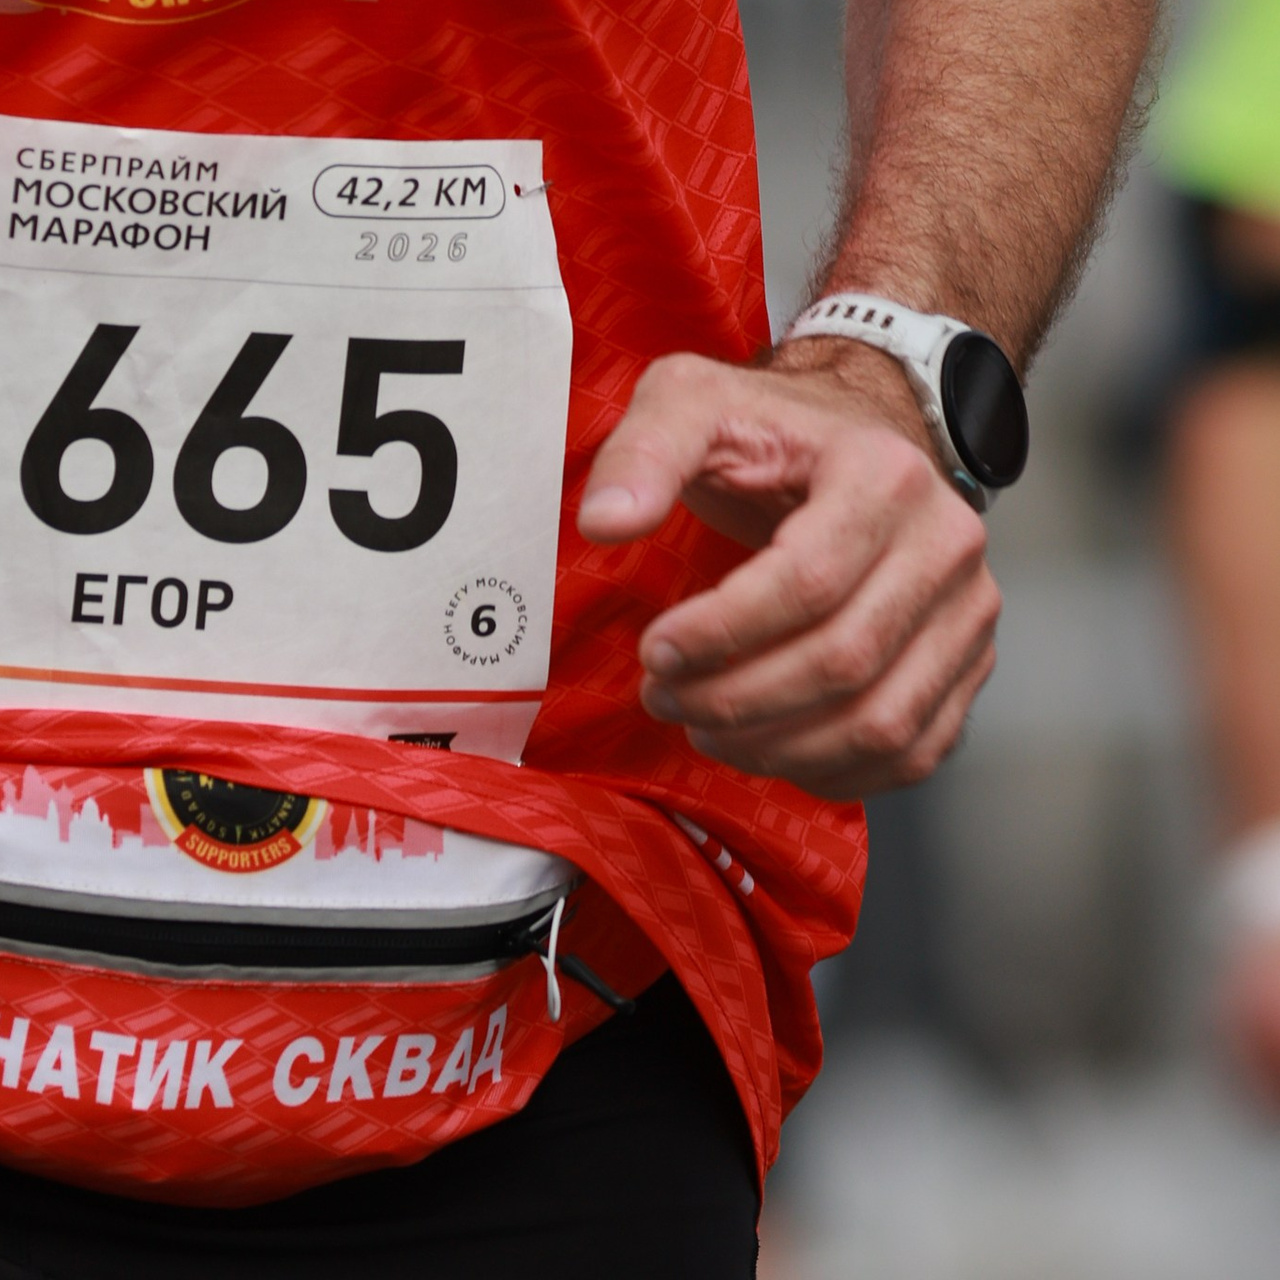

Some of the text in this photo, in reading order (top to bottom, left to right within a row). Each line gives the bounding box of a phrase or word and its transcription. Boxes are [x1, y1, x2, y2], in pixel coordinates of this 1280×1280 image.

[15, 146, 219, 182] СБЕРПРАЙМ
[11, 176, 288, 221] МОСКОВСКИЙ
[336, 176, 487, 212] 42,2 КМ
[8, 211, 212, 252] МАРАФОН
[355, 231, 469, 262] 2026
[69, 572, 235, 631] ЕГОР
[470, 603, 497, 638] 6
[443, 577, 528, 666] БЕГУ МОСКОВСКИЙ МАРАФОН
[185, 833, 292, 869] SUPPORTERS
[271, 1003, 509, 1109] СКВАД
